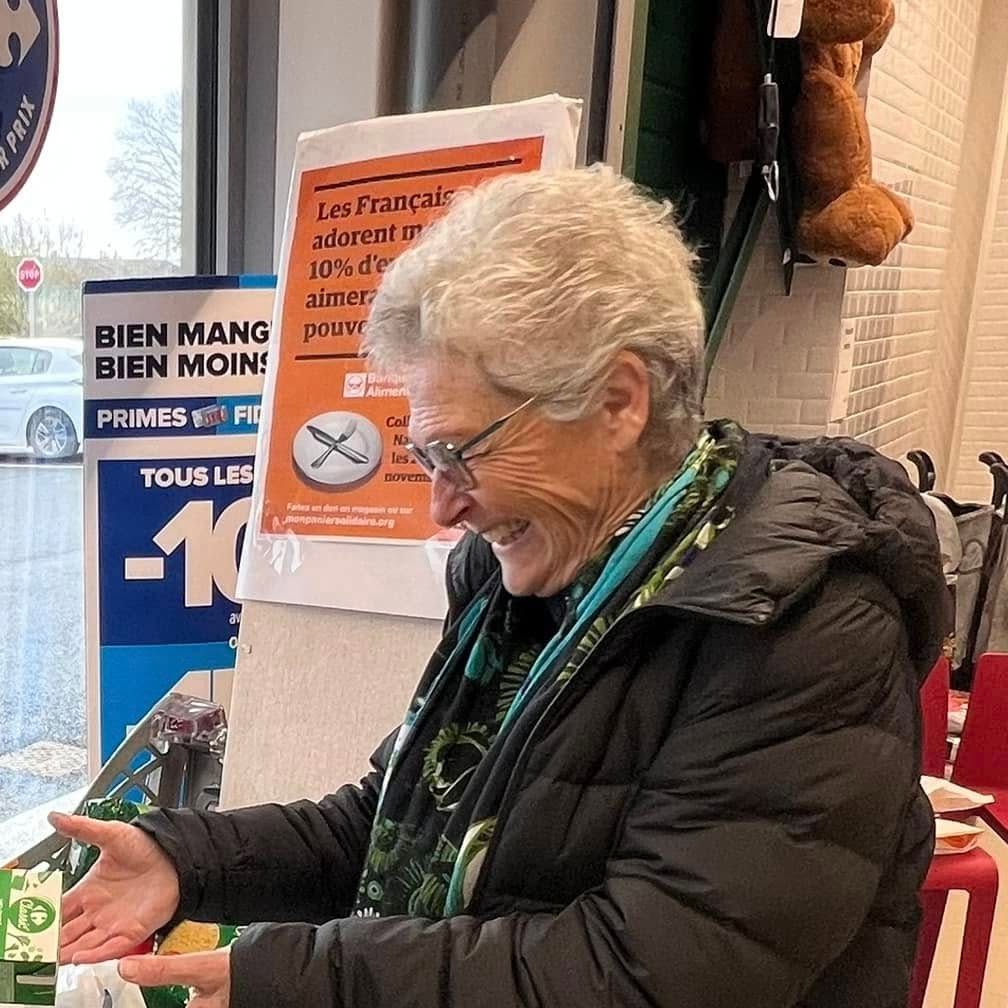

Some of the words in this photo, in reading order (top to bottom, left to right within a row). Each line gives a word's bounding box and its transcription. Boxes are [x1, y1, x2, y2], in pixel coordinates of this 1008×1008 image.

[6, 94, 35, 154] PRIX
[316, 201, 352, 222] Les
[312, 223, 398, 251] adorent
[20, 271, 39, 280] STOP
[309, 257, 353, 280] 10%
[95, 324, 168, 349] BIEN
[178, 320, 273, 346] MANG
[95, 355, 168, 380] BIEN
[97, 407, 188, 429] PRIMES
[392, 452, 409, 464] les
[141, 467, 209, 488] TOUS
[213, 464, 254, 486] LES
